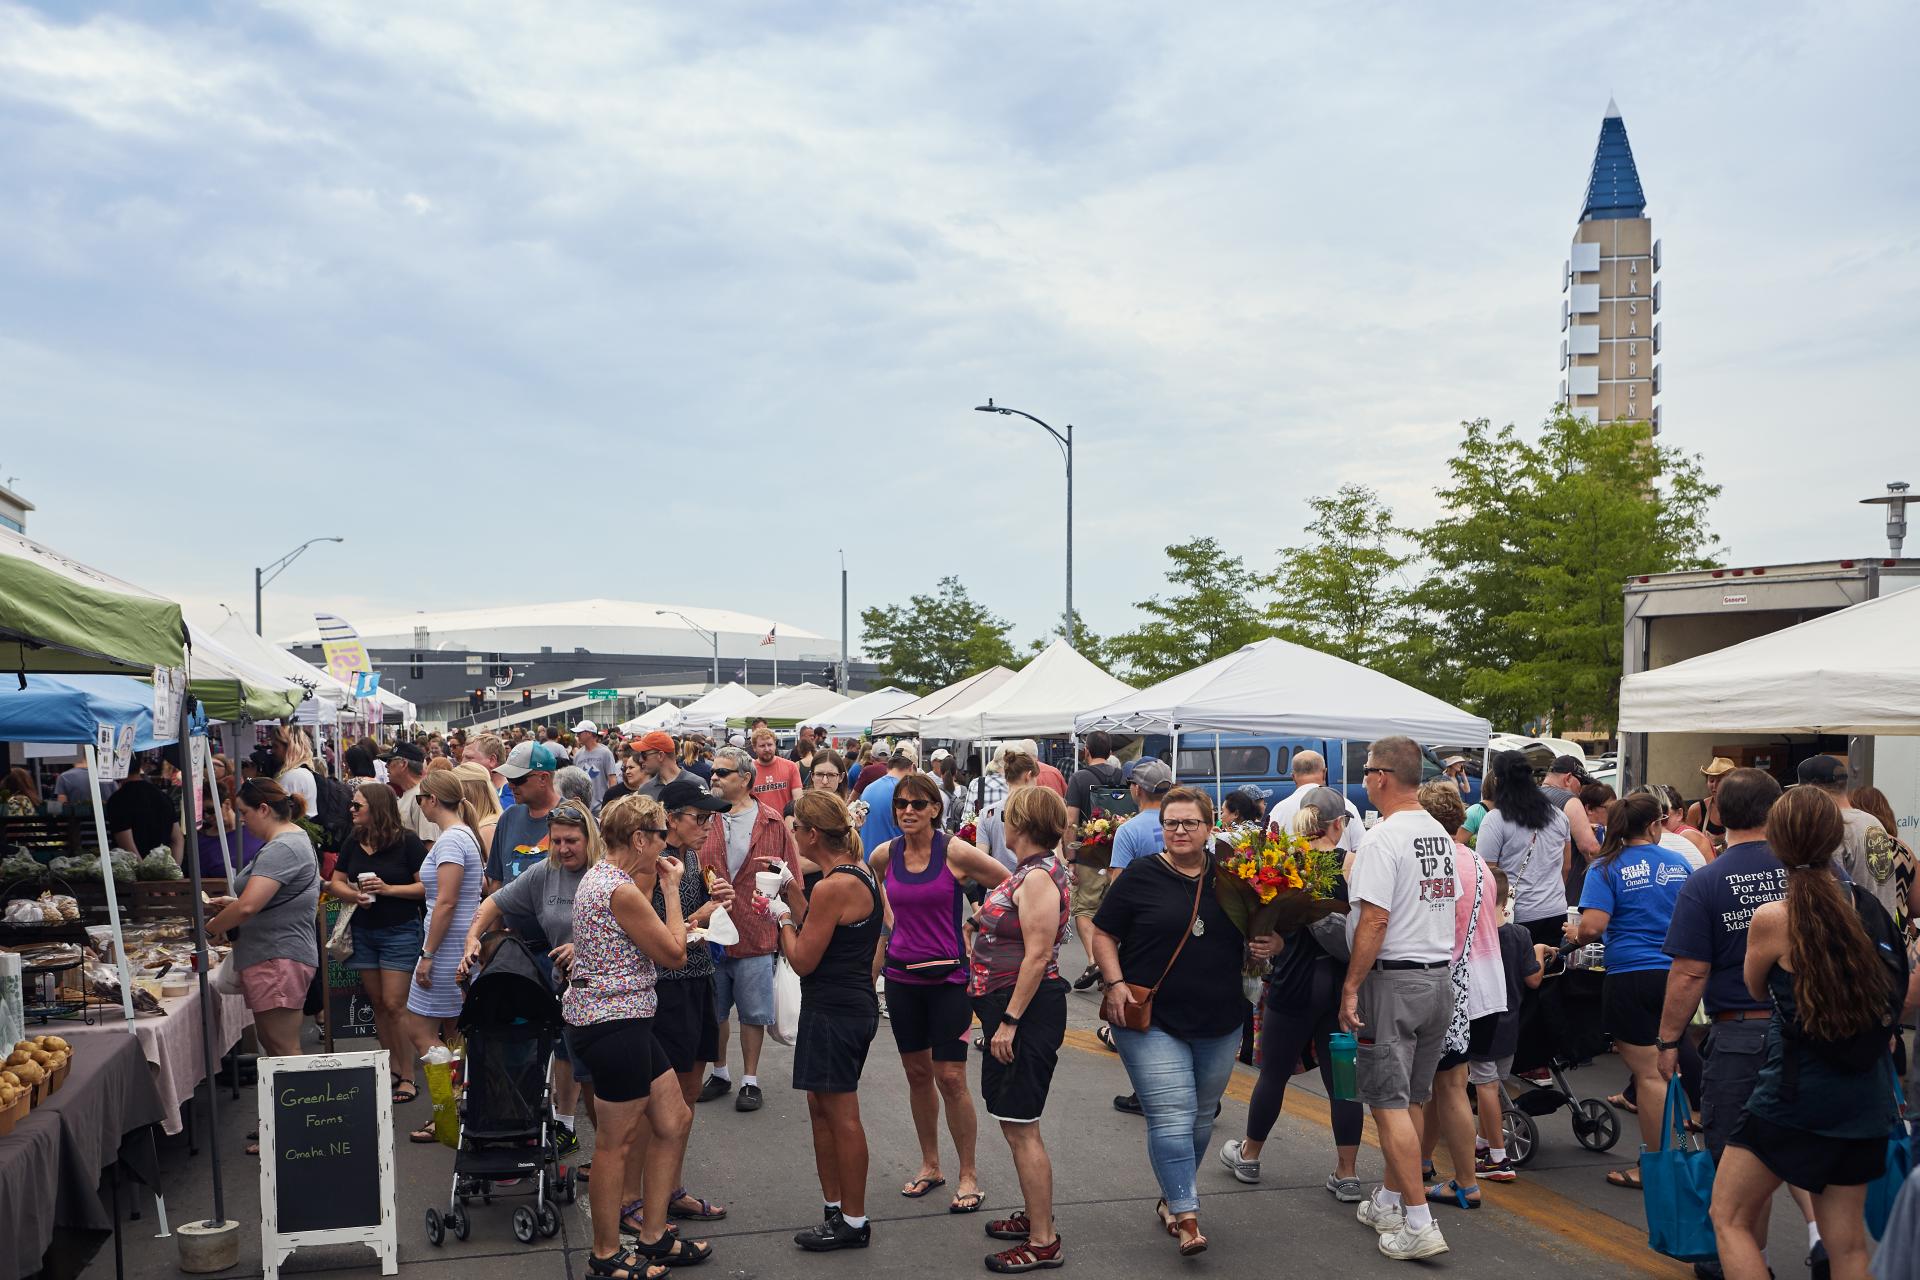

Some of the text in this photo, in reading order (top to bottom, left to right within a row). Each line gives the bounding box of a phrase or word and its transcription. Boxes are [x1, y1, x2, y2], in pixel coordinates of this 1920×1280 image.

[1628, 260, 1638, 417] AKSARBEN
[754, 782, 788, 792] NEBRASKA
[1896, 816, 1919, 828] cally
[1413, 837, 1452, 858] SHUT
[1420, 857, 1453, 877] UP &
[1622, 870, 1650, 880] CARPET
[1726, 871, 1772, 885] There's
[1626, 878, 1649, 887] Omaha
[1731, 884, 1754, 895] For
[1758, 881, 1775, 891] All
[1740, 892, 1788, 904] Creatur
[1726, 920, 1751, 931] Mas
[306, 1114, 343, 1127] Farms
[330, 1142, 351, 1155] NE
